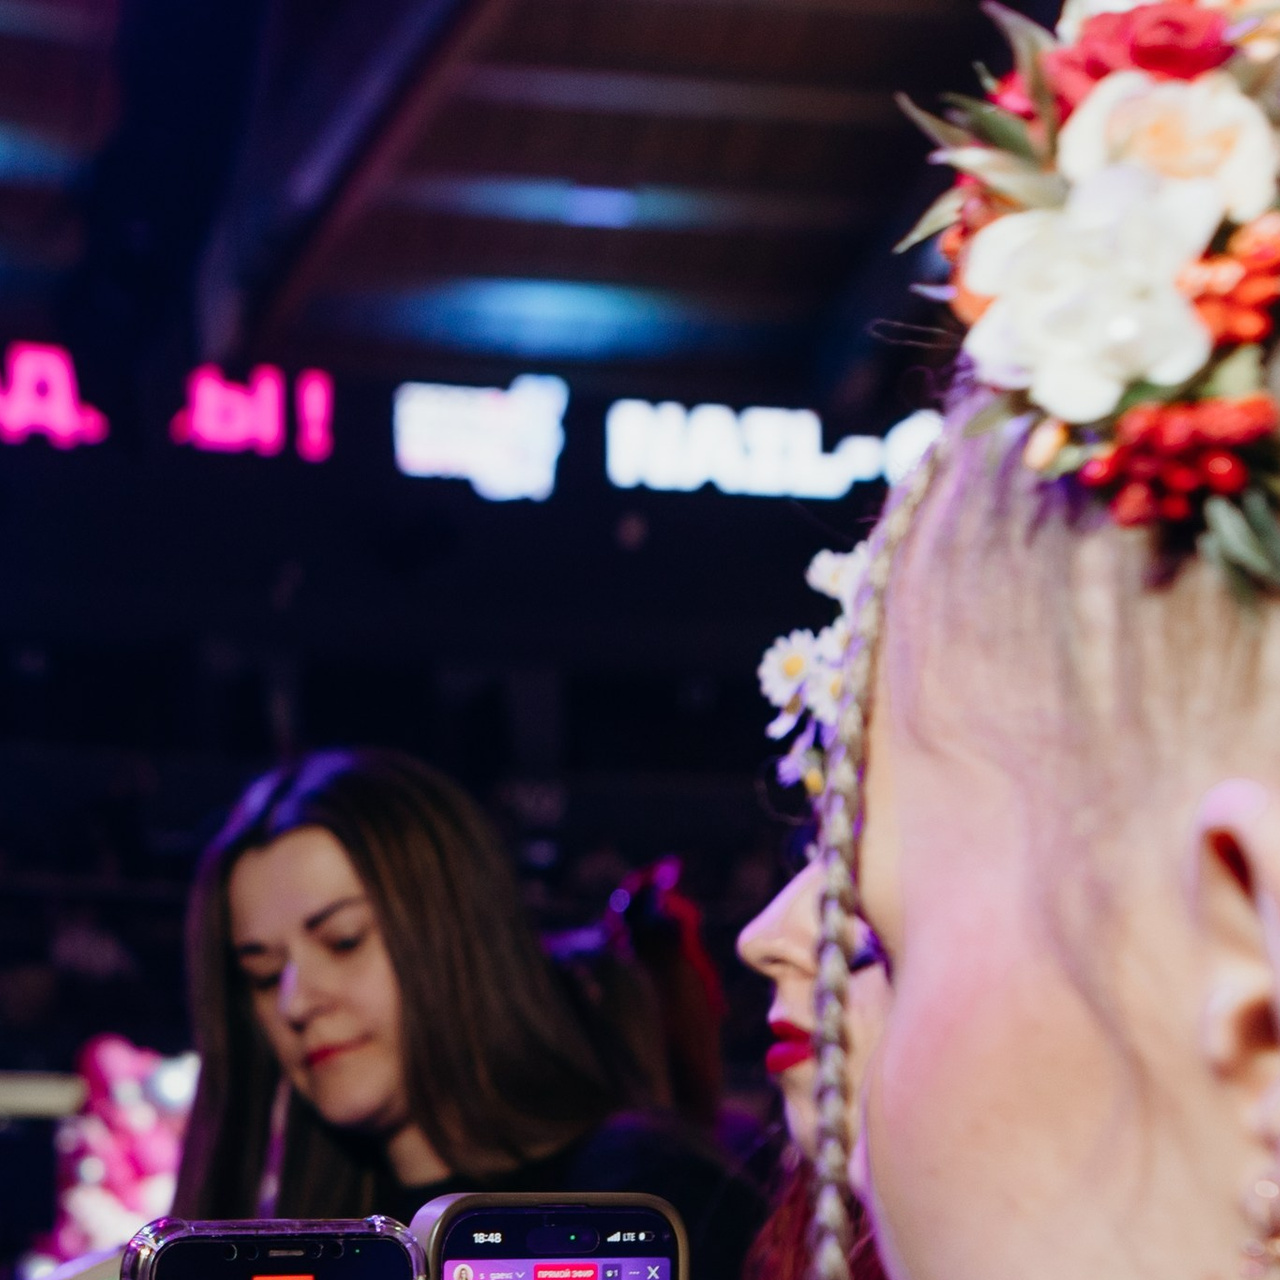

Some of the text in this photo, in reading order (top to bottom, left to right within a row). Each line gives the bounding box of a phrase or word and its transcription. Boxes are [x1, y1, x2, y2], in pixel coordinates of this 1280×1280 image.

[473, 1232, 503, 1243] 18:48
[622, 1232, 636, 1242] LTE
[537, 1268, 595, 1278] ПРЯМОЙ ЭФИР
